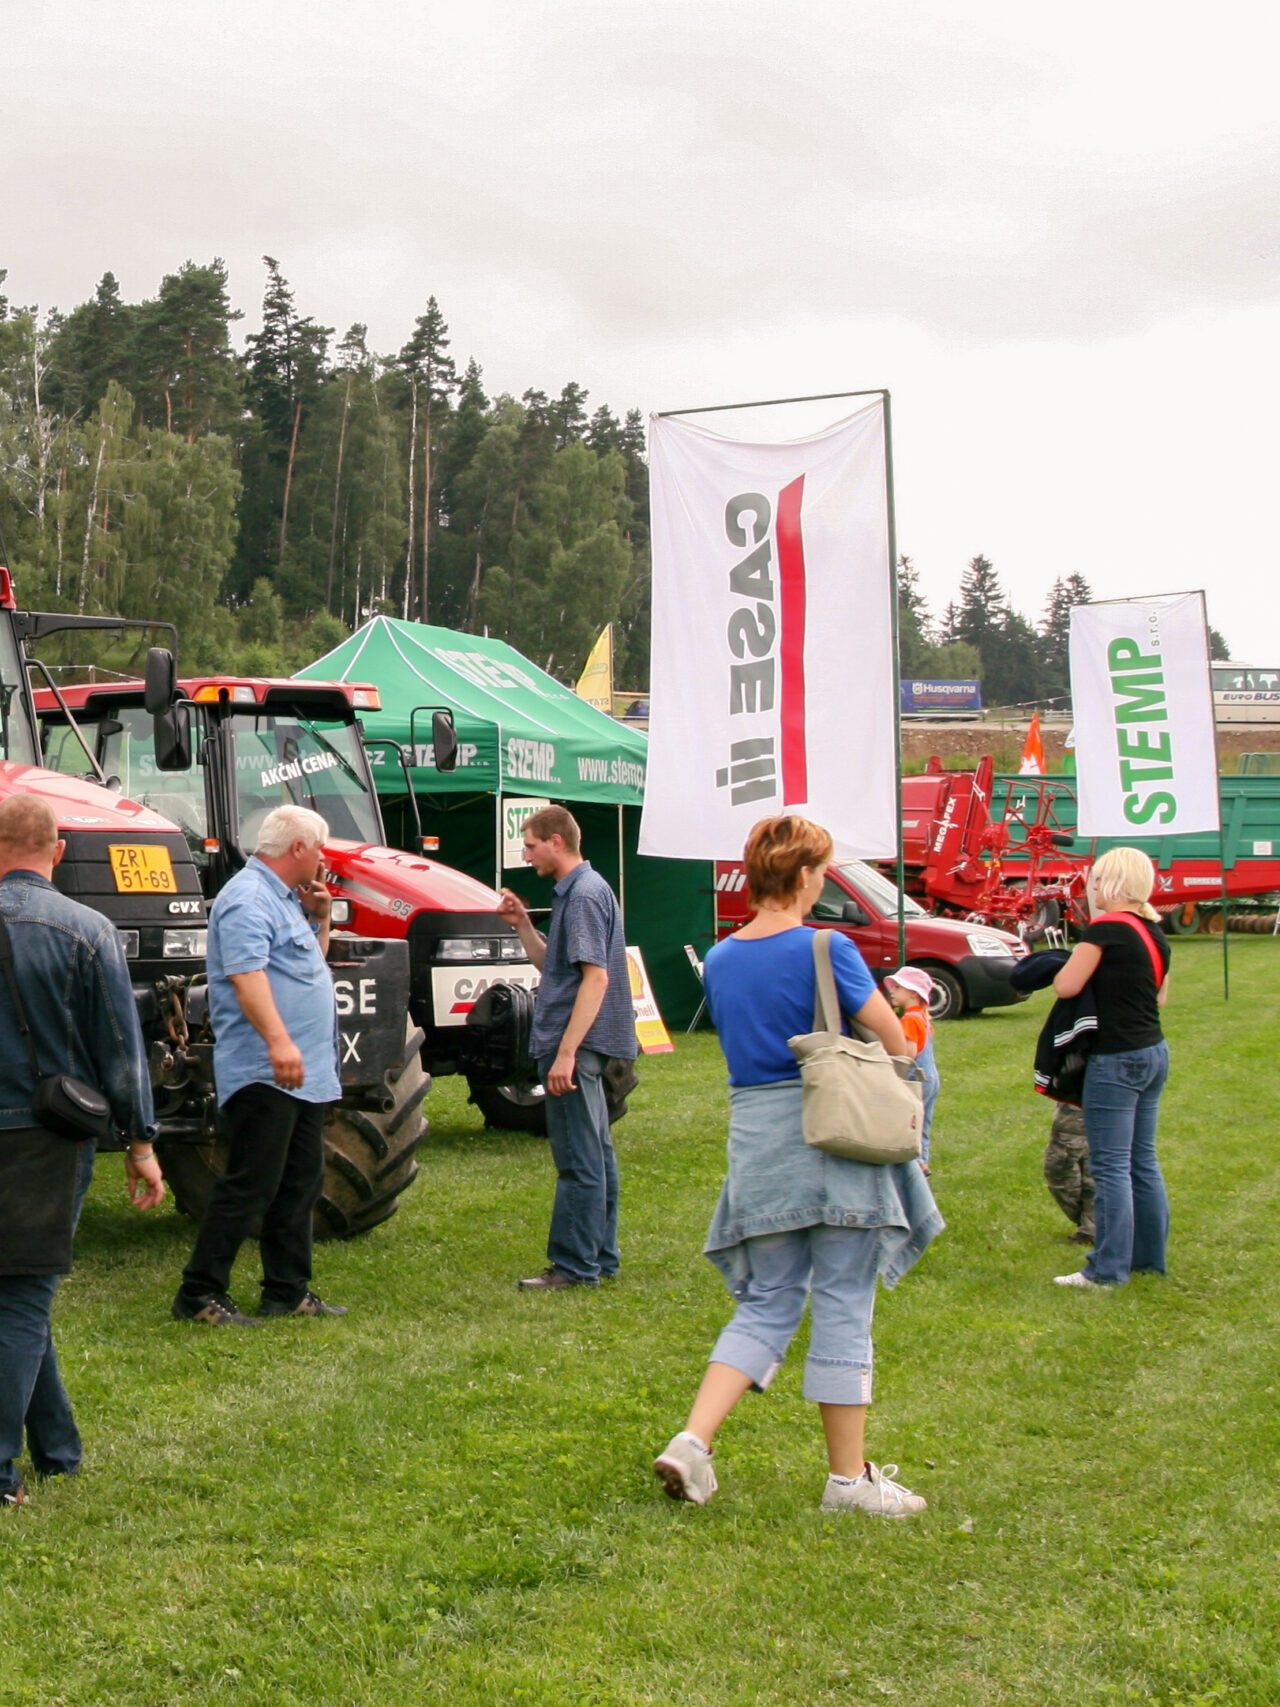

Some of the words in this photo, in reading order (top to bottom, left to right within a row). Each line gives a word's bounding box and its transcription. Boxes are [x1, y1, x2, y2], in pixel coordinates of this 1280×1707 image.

[923, 683, 976, 694] Husqvarna
[1107, 637, 1177, 824] STEMP
[261, 759, 302, 787] AKČNÍ
[302, 752, 337, 774] CENA
[507, 738, 555, 781] STEMP
[577, 756, 646, 795] www.stemp.
[933, 797, 957, 852] MEGAFEX
[122, 870, 169, 888] 51-69
[169, 902, 200, 913] CVX
[390, 900, 412, 917] 95
[636, 1004, 655, 1016] hell
